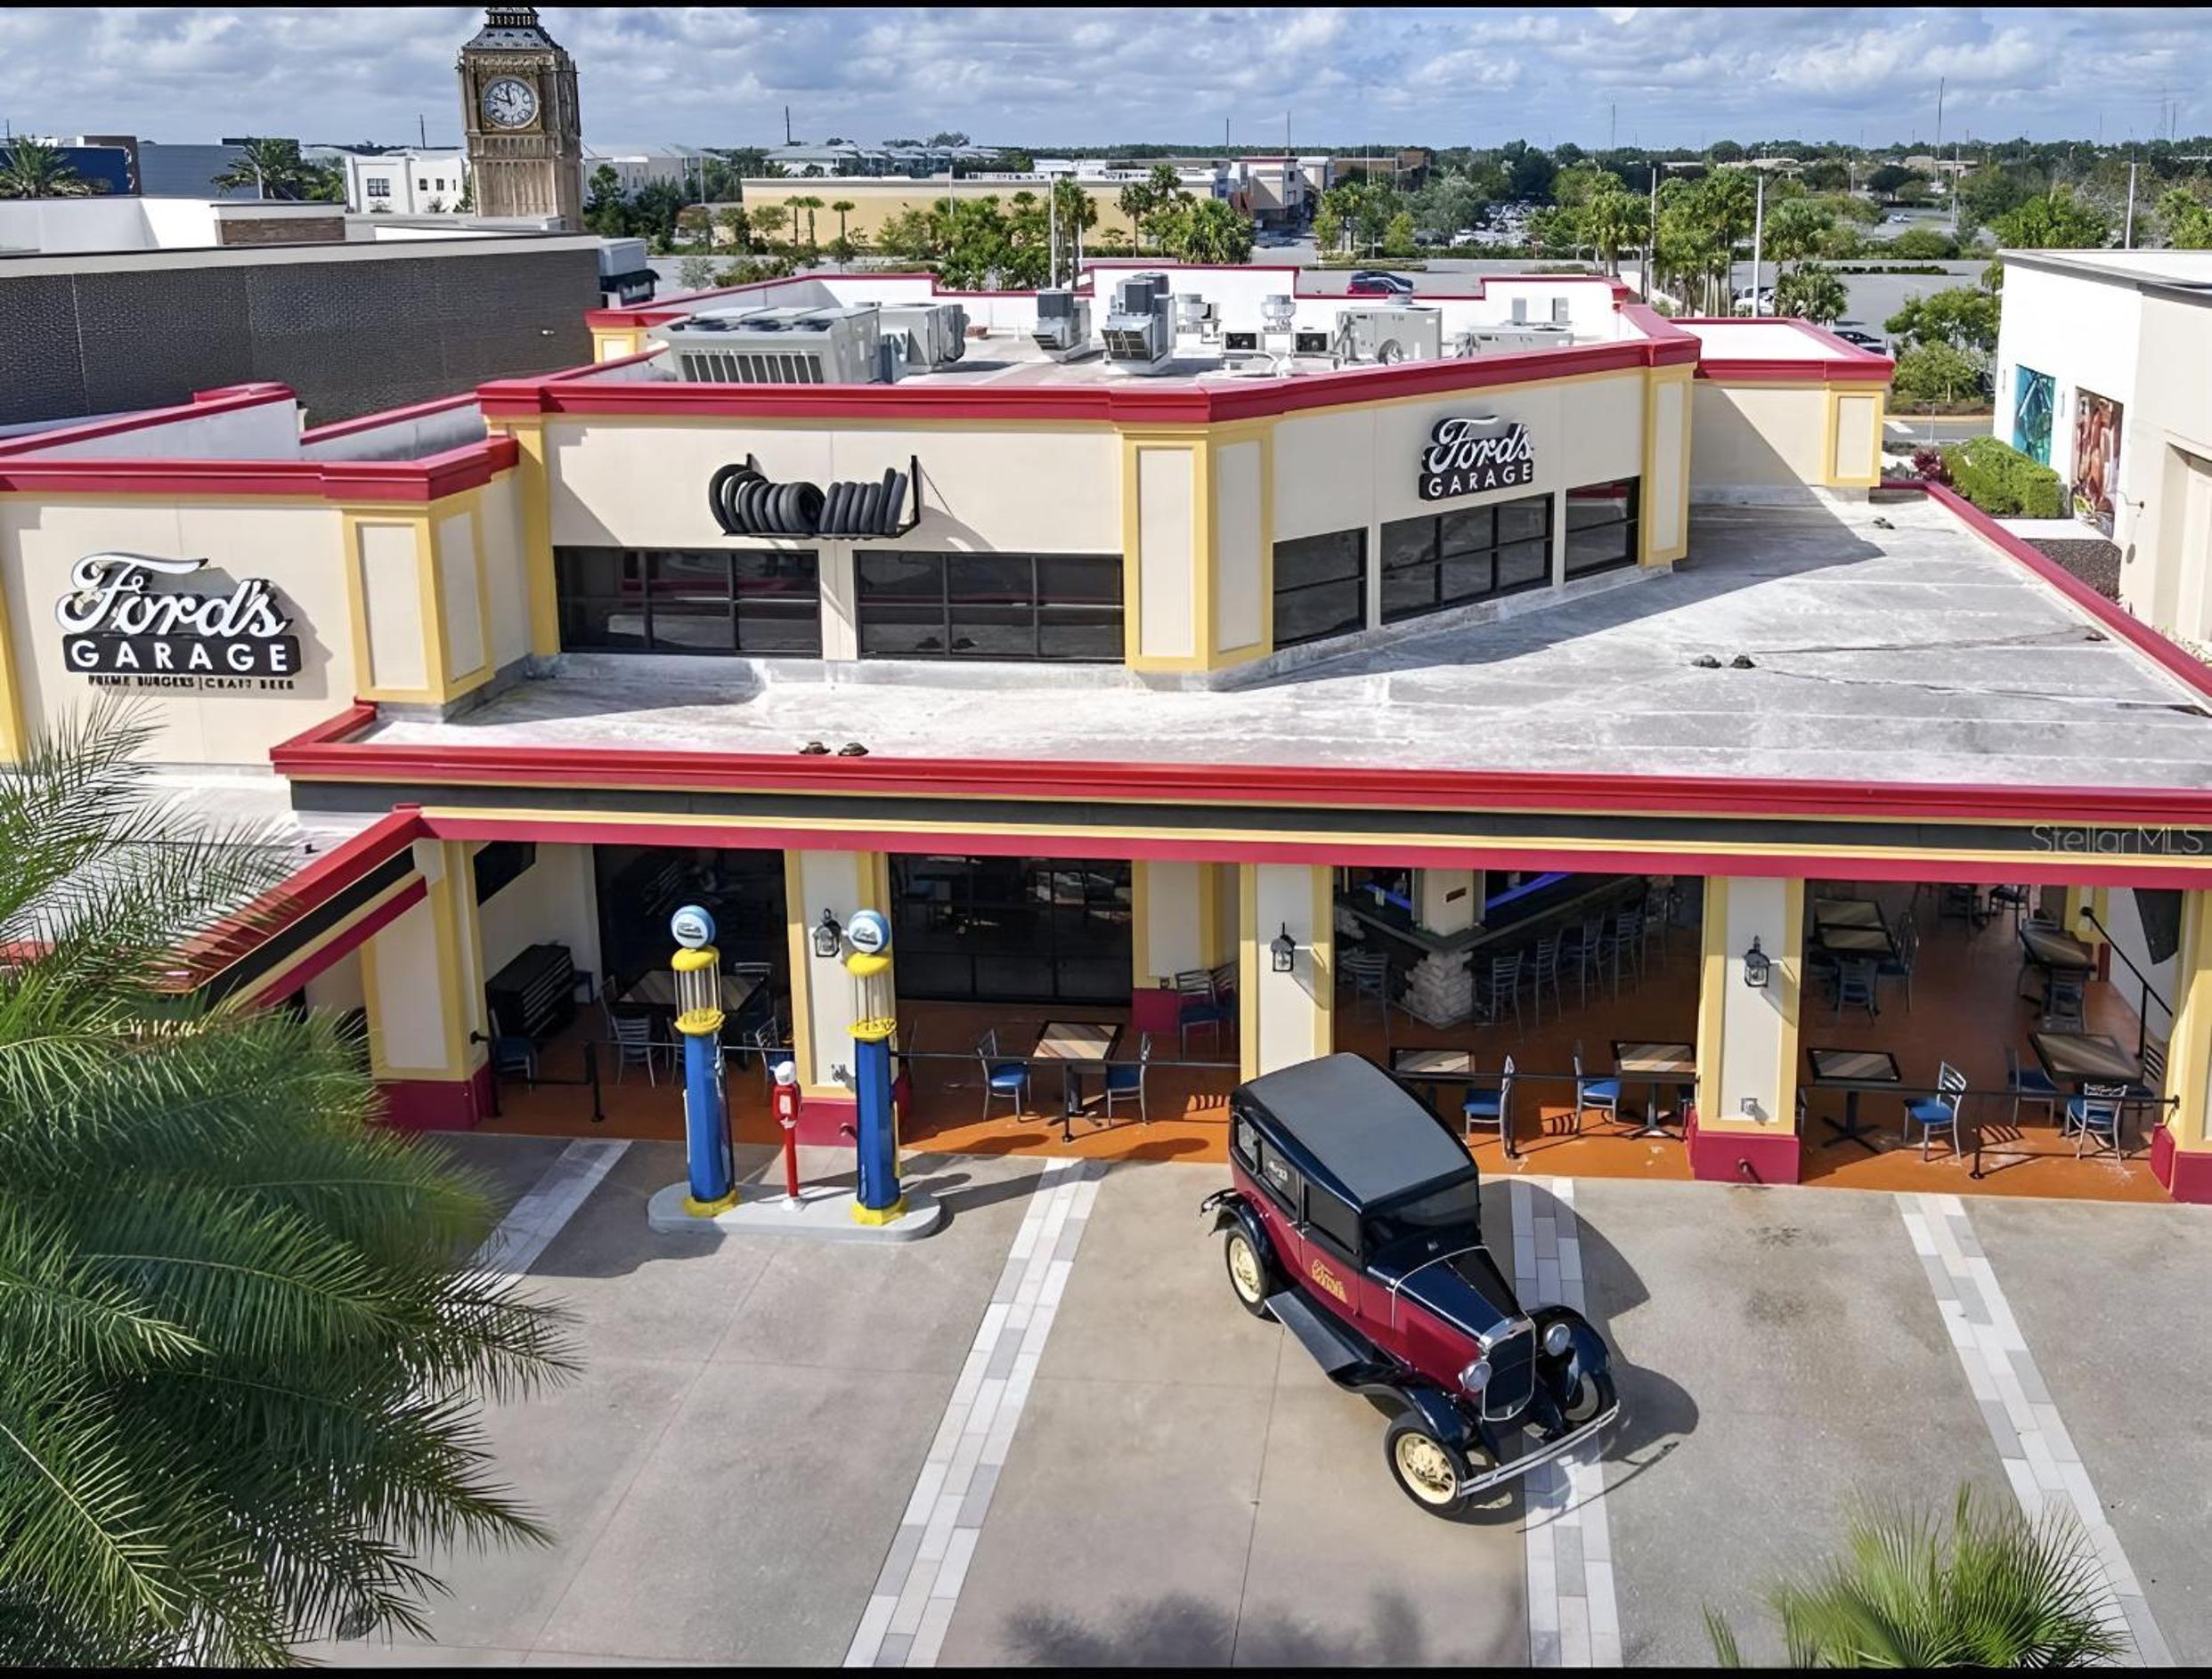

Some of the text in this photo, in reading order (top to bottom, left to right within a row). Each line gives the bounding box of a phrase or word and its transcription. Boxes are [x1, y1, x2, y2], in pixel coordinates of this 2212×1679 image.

[1427, 416, 1533, 474] Ford's
[1427, 463, 1532, 497] GARAGE
[55, 552, 294, 638] Ford's
[70, 639, 289, 672] GARAGE
